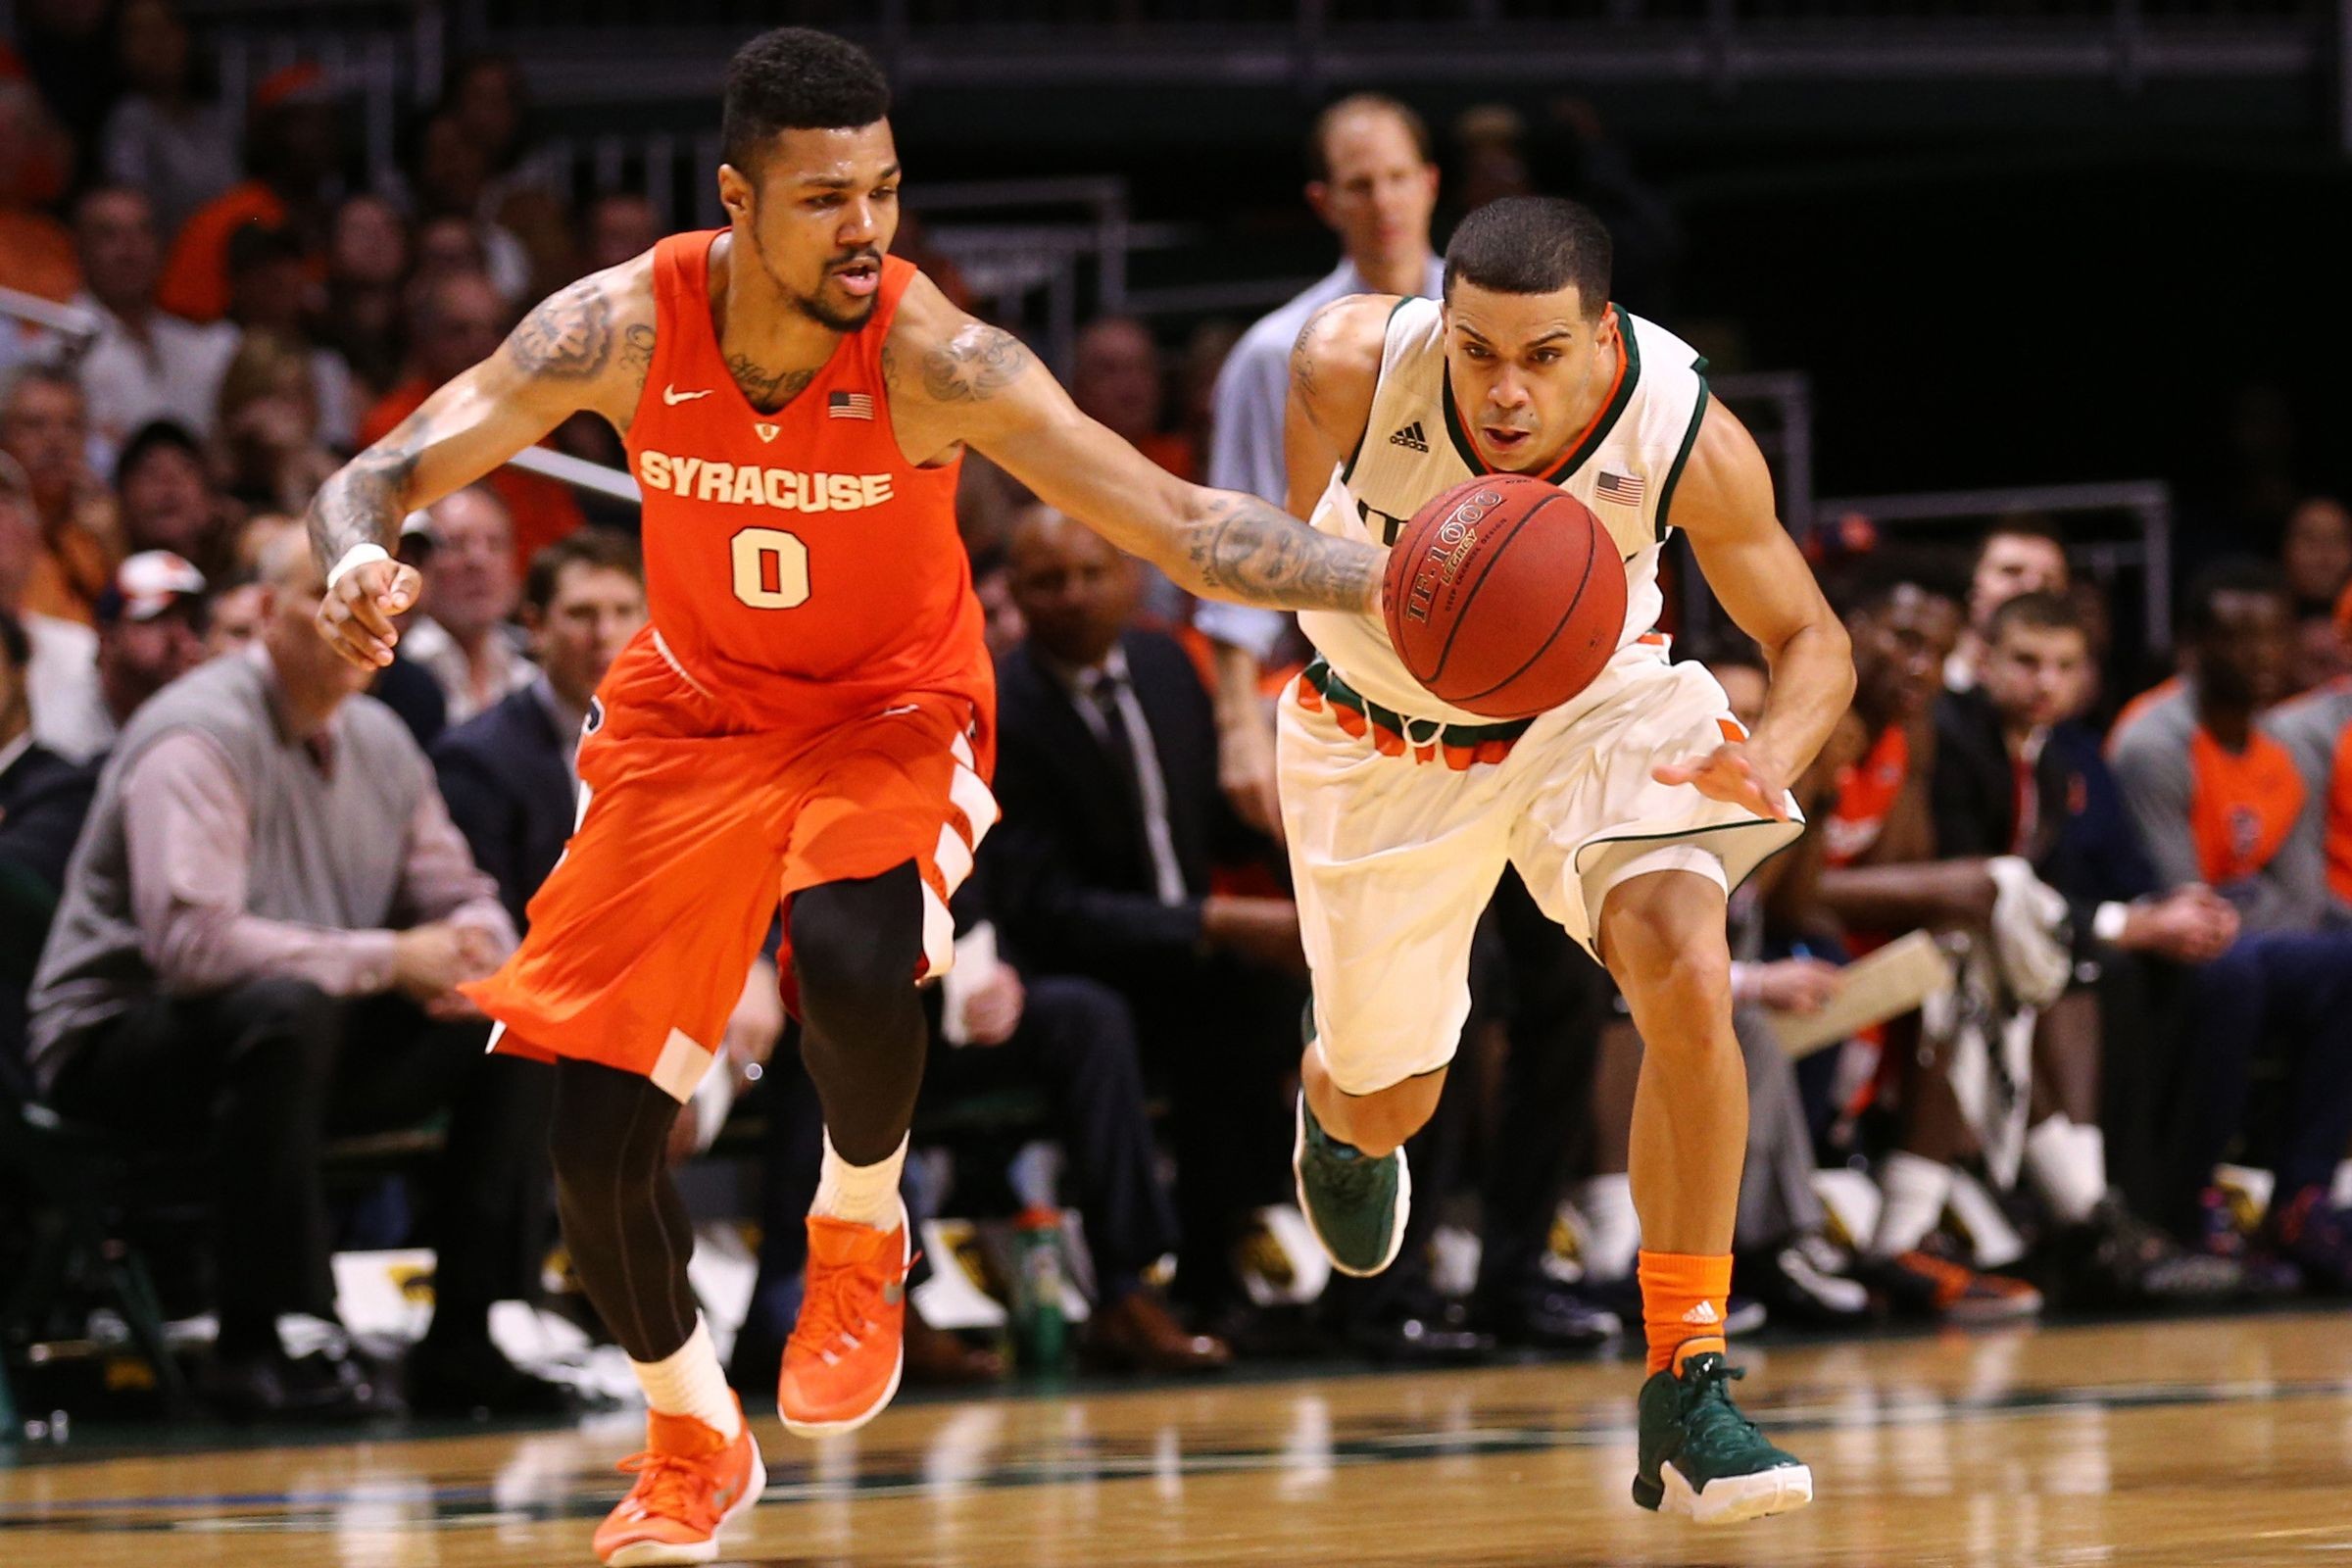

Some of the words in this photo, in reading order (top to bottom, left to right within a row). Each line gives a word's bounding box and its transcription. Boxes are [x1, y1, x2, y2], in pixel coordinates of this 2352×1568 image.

[1390, 434, 1429, 454] adidas
[640, 450, 894, 514] SYRACUSE
[730, 526, 811, 610] 0
[1405, 491, 1501, 624] TF-1000
[1440, 527, 1478, 586] LEGACY
